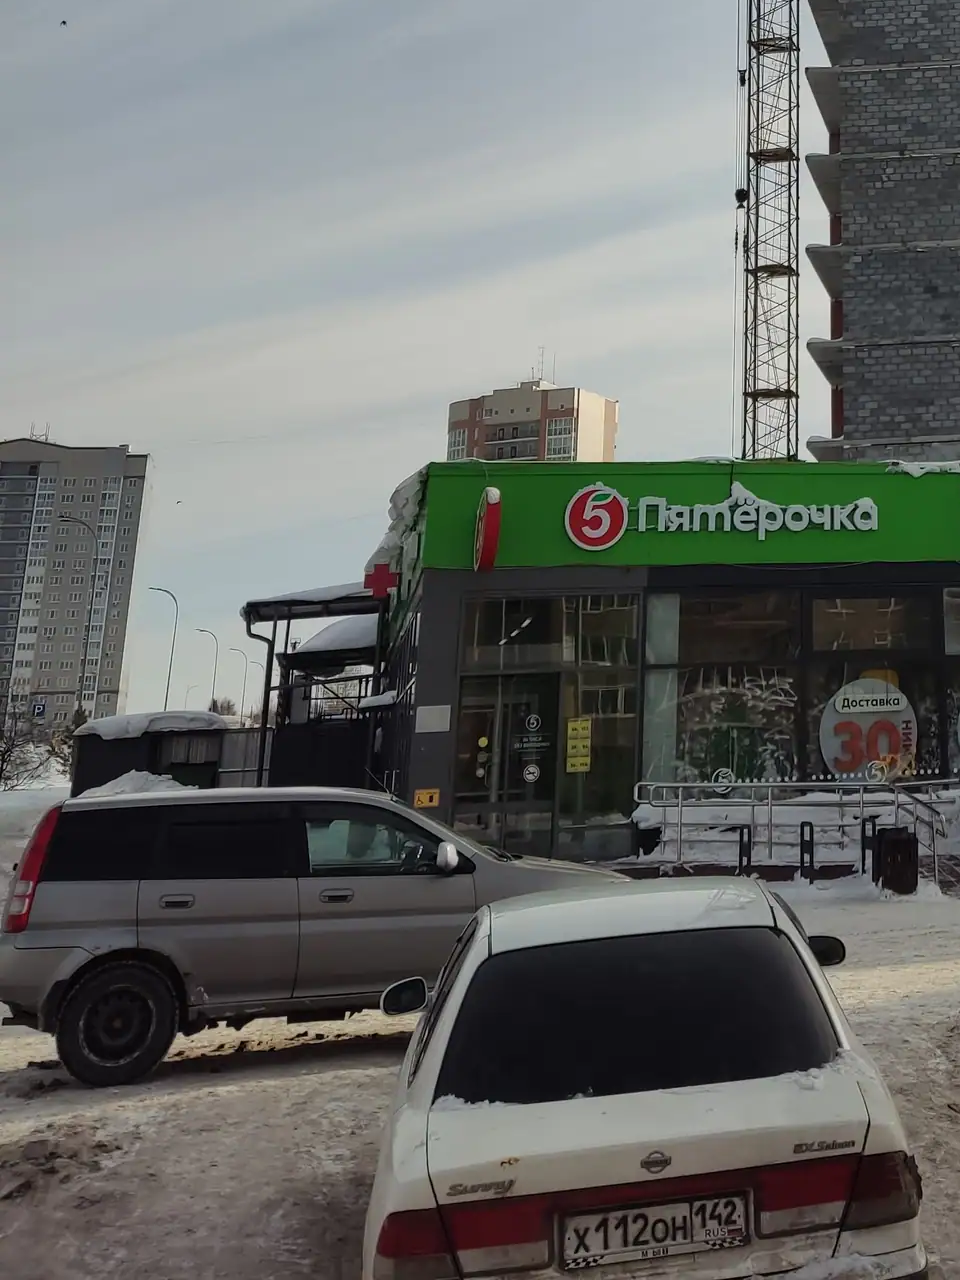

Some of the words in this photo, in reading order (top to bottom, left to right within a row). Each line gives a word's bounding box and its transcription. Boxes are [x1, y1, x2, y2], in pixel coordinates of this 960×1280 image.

[841, 697, 900, 710] Доставка
[833, 719, 900, 773] 30
[446, 1177, 515, 1196] Sunny
[694, 1199, 738, 1229] 142
[704, 1227, 727, 1238] RUS
